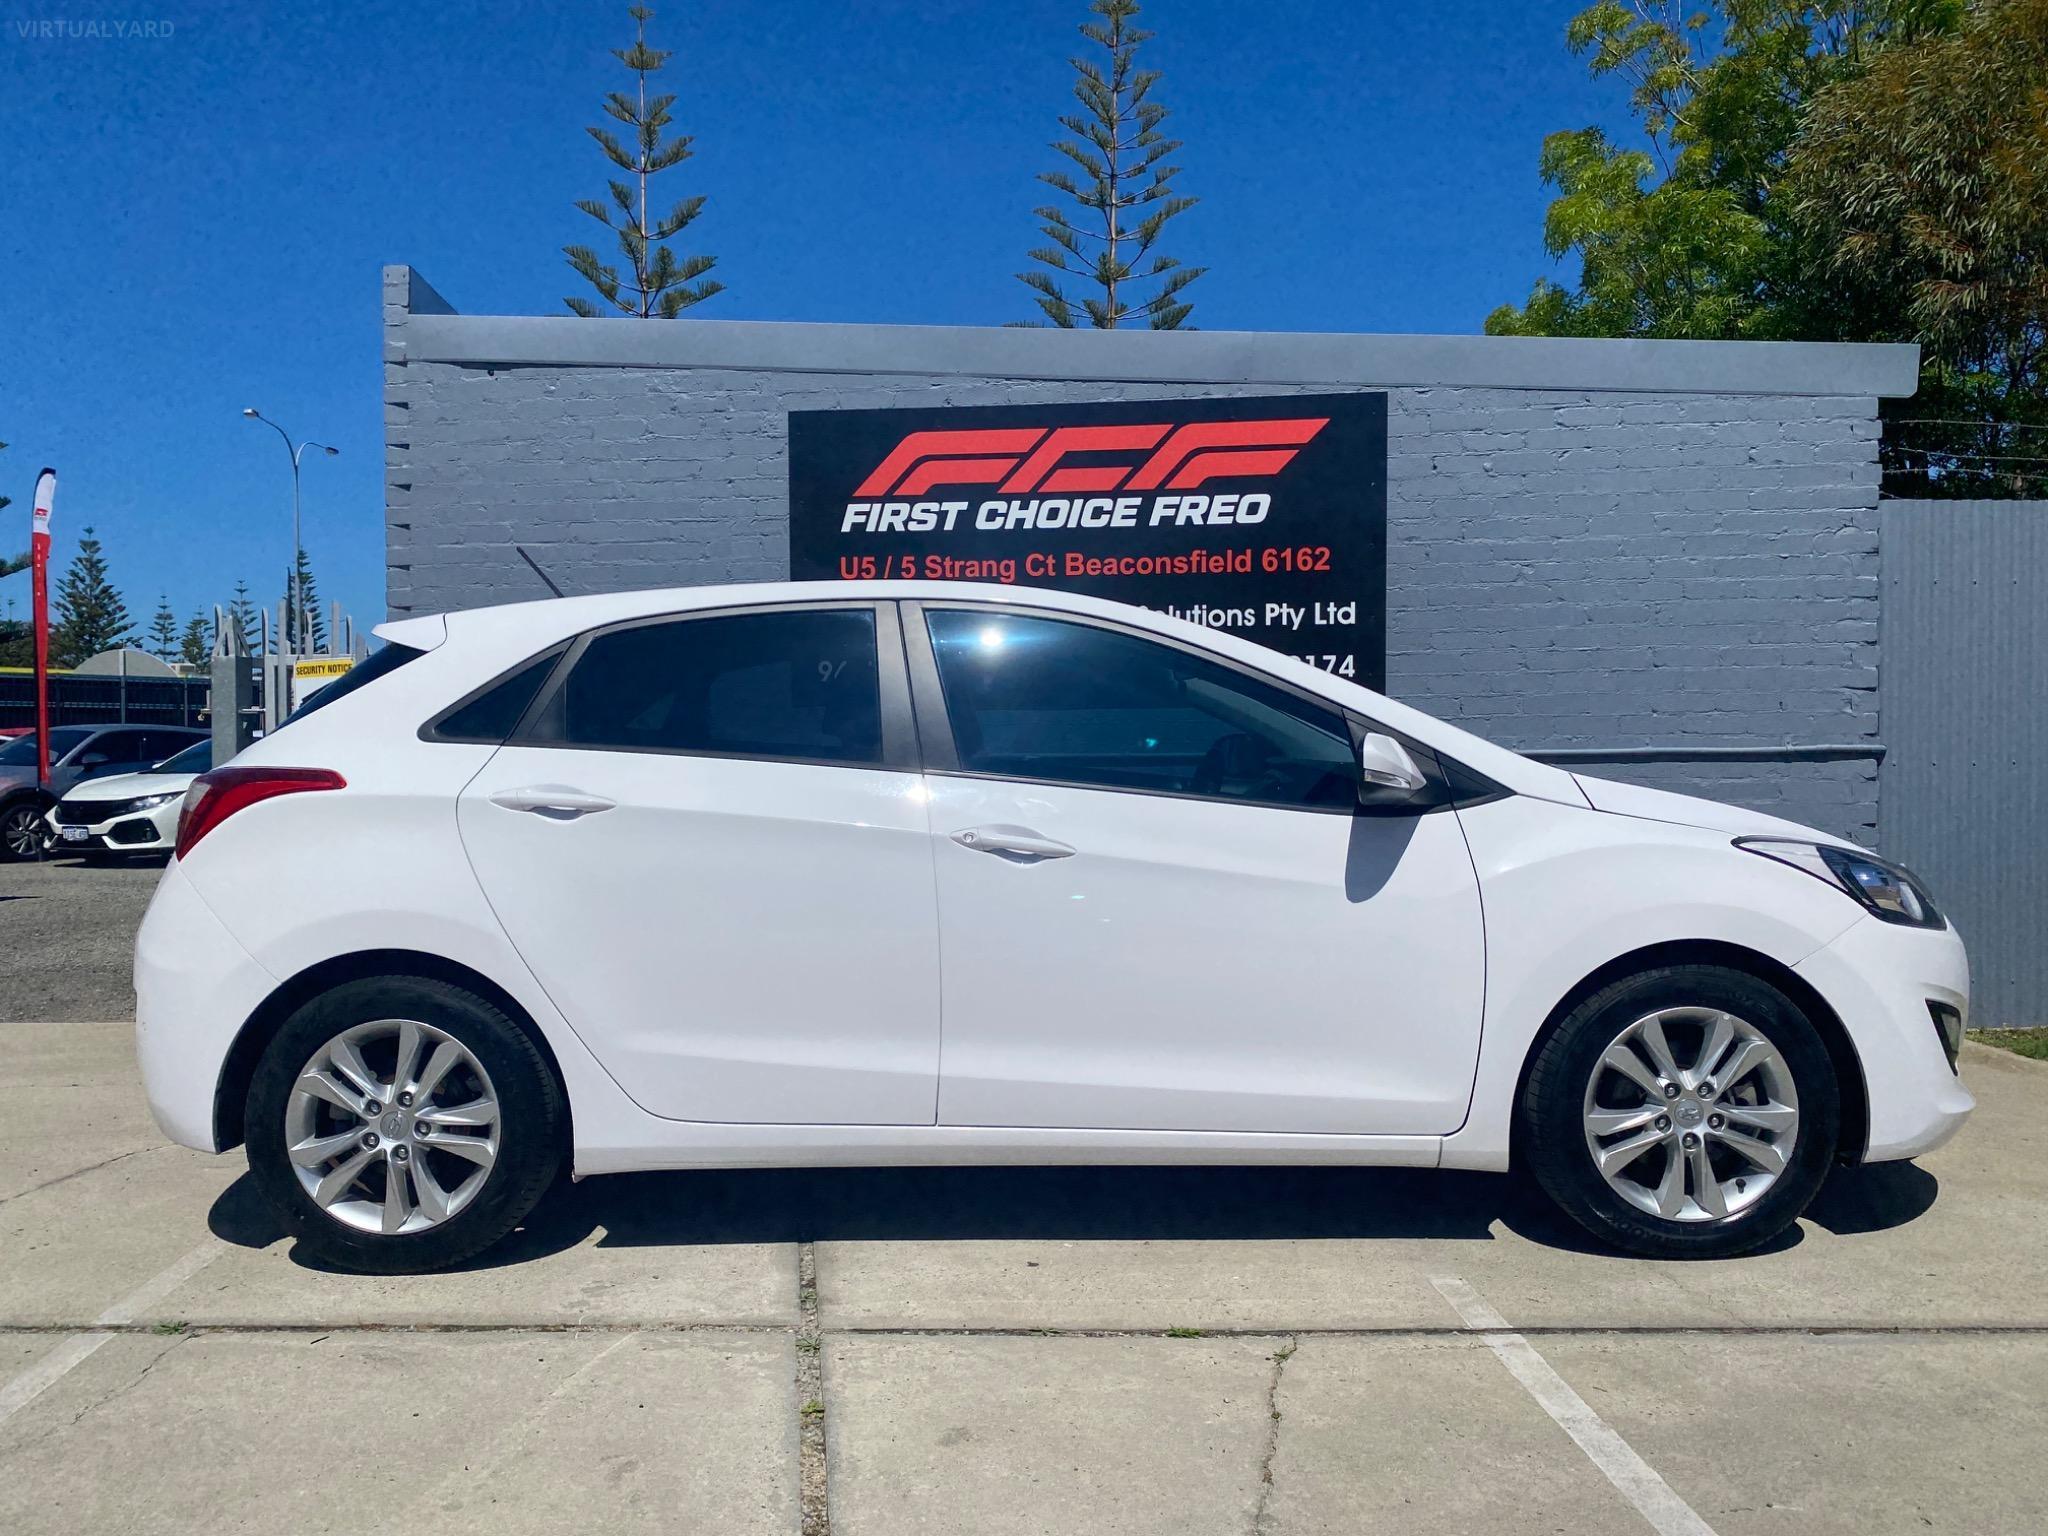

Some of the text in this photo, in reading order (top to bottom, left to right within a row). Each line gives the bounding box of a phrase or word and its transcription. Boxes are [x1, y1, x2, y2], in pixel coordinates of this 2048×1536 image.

[840, 493, 1272, 533] FIRST CHOICE FREO
[839, 547, 1331, 584] U5 / 5 Strang Ct Beaconsfield 6162
[1138, 601, 1356, 631] lutions Pty Ltd
[296, 665, 325, 676] SECURITY
[1288, 654, 1356, 678] 174
